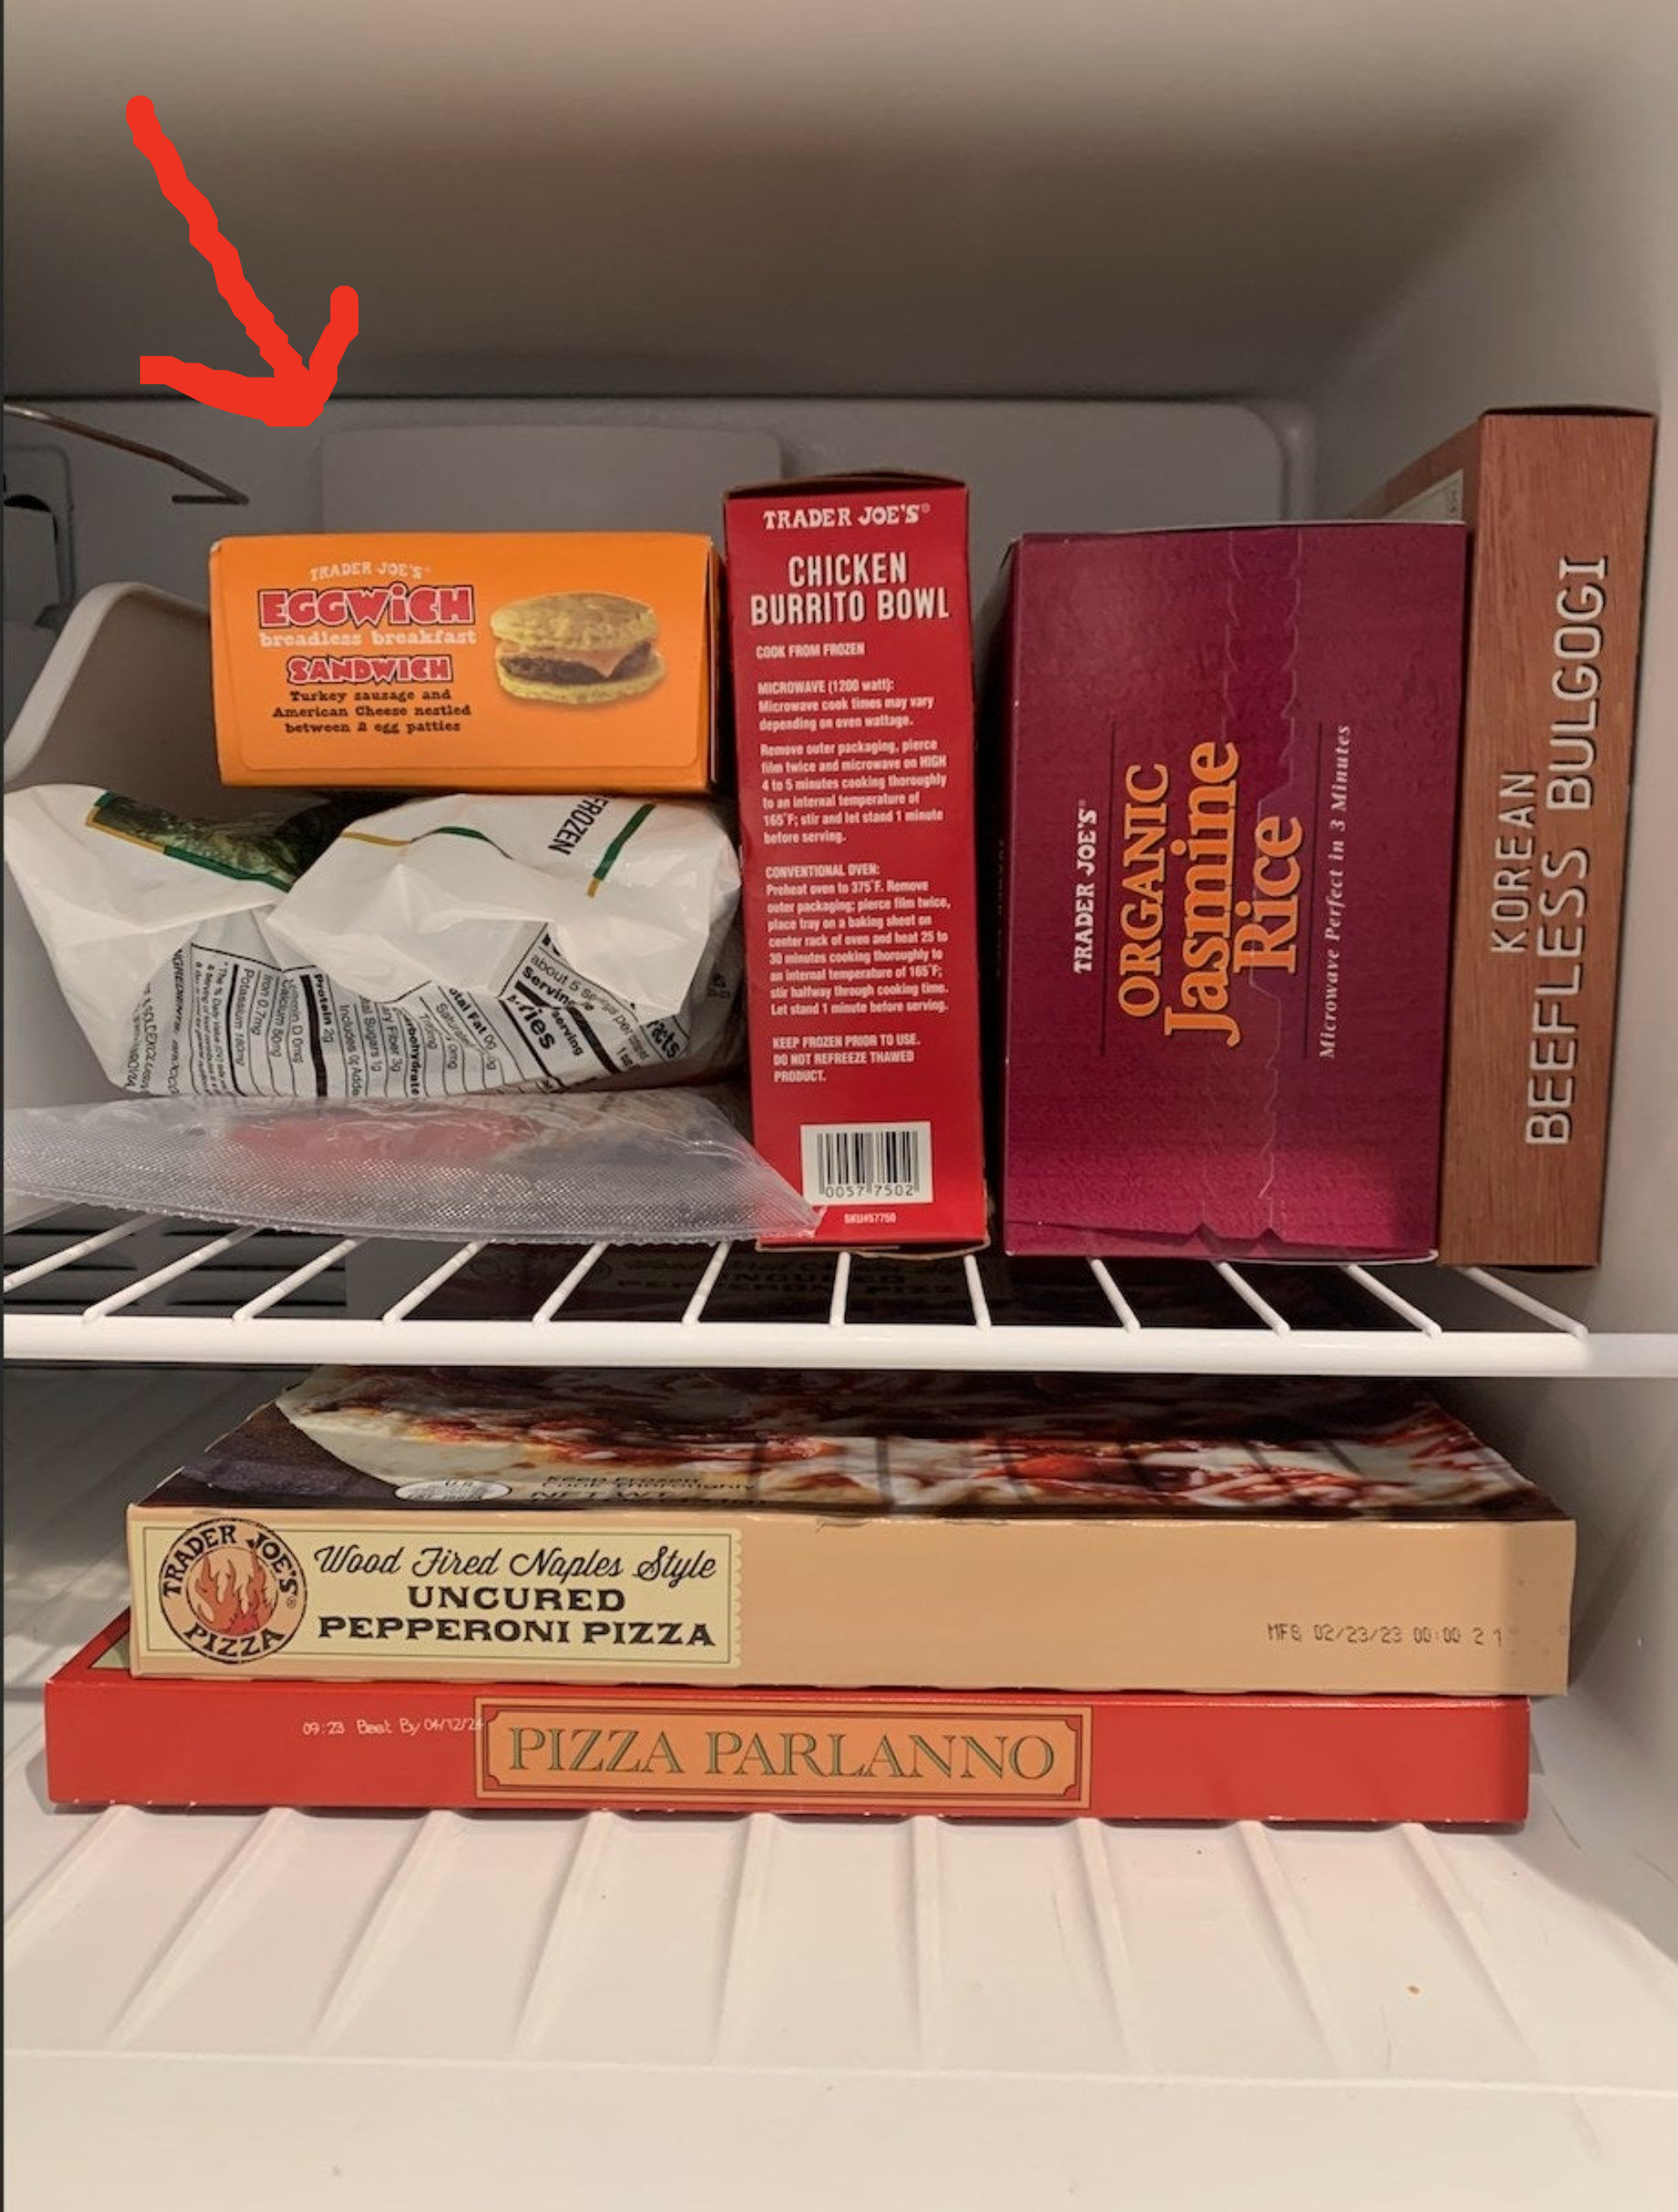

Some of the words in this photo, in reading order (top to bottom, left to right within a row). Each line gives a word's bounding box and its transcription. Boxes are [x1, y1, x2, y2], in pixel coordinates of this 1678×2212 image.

[763, 508, 852, 530] TRADER
[857, 503, 921, 526] JOE'S
[310, 562, 372, 581] TRADER
[788, 551, 907, 588] CHICKEN
[750, 591, 865, 627] BURRITO
[878, 587, 950, 621] BOWL
[259, 631, 362, 648] breadless
[373, 629, 477, 646] breakfast
[756, 644, 785, 659] COOK
[789, 644, 821, 658] FROM
[823, 642, 864, 656] FROZEN
[286, 655, 454, 684] SANDWICH
[289, 690, 347, 703] Turkey
[354, 691, 416, 703] sausage
[422, 689, 451, 700] and
[758, 680, 825, 695] MICROWAVE
[828, 678, 859, 693] (1200
[1546, 556, 1609, 812] BULGOGI
[273, 706, 349, 718] American
[355, 705, 408, 717] Cheese
[414, 703, 472, 717] nestled
[758, 699, 819, 712] Microwave
[822, 698, 847, 710] cook
[852, 698, 882, 709] times
[885, 698, 907, 710] may
[909, 696, 934, 710] vary
[284, 721, 351, 734] between
[357, 722, 367, 733] 2
[373, 723, 400, 735] egg
[407, 720, 461, 734] patties
[759, 717, 816, 733] depending
[819, 719, 833, 729] on
[836, 717, 862, 728] oven
[865, 715, 913, 729] wattage.
[760, 743, 804, 756] Remove
[806, 742, 835, 754] outer
[902, 738, 937, 753] pierce
[762, 762, 782, 774] film
[786, 762, 816, 772] twice
[819, 760, 839, 771] and
[842, 759, 900, 770] microwave
[904, 759, 917, 768] on
[920, 755, 946, 768] HIGH
[1331, 725, 1352, 811] Minutes
[762, 780, 769, 790] 4
[772, 780, 783, 790] to
[785, 779, 793, 790] 5
[795, 778, 839, 790] minutes
[842, 776, 884, 790] cooking
[889, 774, 946, 790] thoroughly
[763, 797, 774, 809] to
[777, 799, 789, 807] an
[794, 796, 836, 807] internal
[839, 793, 905, 806] temperature
[909, 792, 920, 804] of
[548, 796, 609, 855] FROZEN
[800, 814, 819, 825] stir
[822, 813, 842, 824] and
[845, 812, 859, 823] let
[862, 811, 894, 823] stand
[896, 811, 901, 822] 1
[905, 808, 943, 822] minute
[1330, 819, 1346, 832] 3
[764, 832, 799, 844] before
[802, 831, 846, 845] serving.
[1076, 808, 1097, 874] JOE'S
[1329, 840, 1345, 862] in
[1491, 770, 1536, 953] KOREAN
[765, 864, 844, 879] CONVENTIONAL
[848, 863, 879, 875] OVEN:
[767, 883, 806, 895] Preheat
[810, 885, 835, 895] oven
[837, 883, 848, 893] to
[887, 879, 928, 892] Remove
[1118, 762, 1169, 1019] ORGANIC
[1165, 741, 1241, 1047] Jasmine
[1233, 815, 1304, 975] Rice
[768, 902, 794, 913] outer
[858, 898, 891, 910] pierce
[894, 898, 915, 908] film
[1325, 869, 1347, 942] Perfect
[1074, 883, 1095, 974] TRADER
[531, 954, 568, 987] about
[235, 968, 255, 1030] Potassium
[275, 979, 290, 1026] Calcium
[314, 973, 332, 1026] Protein
[771, 1004, 787, 1015] Let
[790, 1004, 819, 1015] stand
[823, 1004, 827, 1014] 1
[831, 1002, 868, 1014] minute
[870, 1001, 904, 1013] before
[906, 1000, 948, 1014] serving.
[1319, 948, 1340, 1059] Microwave
[1524, 848, 1590, 1146] BEEFLESS
[322, 1029, 335, 1043] 2g
[467, 1011, 487, 1036] Fat
[364, 1018, 380, 1058] Sugars
[387, 1025, 399, 1052] Fiber
[773, 1036, 800, 1049] KEEP
[802, 1036, 842, 1047] FROZEN
[845, 1035, 878, 1046] PRIOR
[879, 1034, 894, 1045] TO
[896, 1033, 920, 1046] USE.
[774, 1054, 787, 1066] DO
[792, 1054, 810, 1064] NOT
[816, 1052, 867, 1065] REFREEZE
[871, 1051, 915, 1063] THAWED
[774, 1070, 826, 1083] PRODUCT.
[826, 1186, 865, 1198] 0057
[874, 1184, 914, 1197] 7502
[162, 1524, 237, 1599] TRADER
[314, 1545, 404, 1575] Wood
[412, 1546, 503, 1577] Fired
[509, 1547, 624, 1584] Naples
[632, 1546, 717, 1589] Style
[407, 1585, 626, 1612] UNCURED
[183, 1621, 285, 1657] PIZZA
[318, 1615, 571, 1644] PEPPERONI
[582, 1620, 717, 1646] PIZZA
[1313, 1623, 1403, 1645] 02/23/23
[303, 1721, 346, 1735] 09:23
[356, 1719, 393, 1735] Best
[399, 1717, 420, 1736] By
[508, 1726, 685, 1775] PIZZA
[705, 1730, 1056, 1781] PARLANNO
